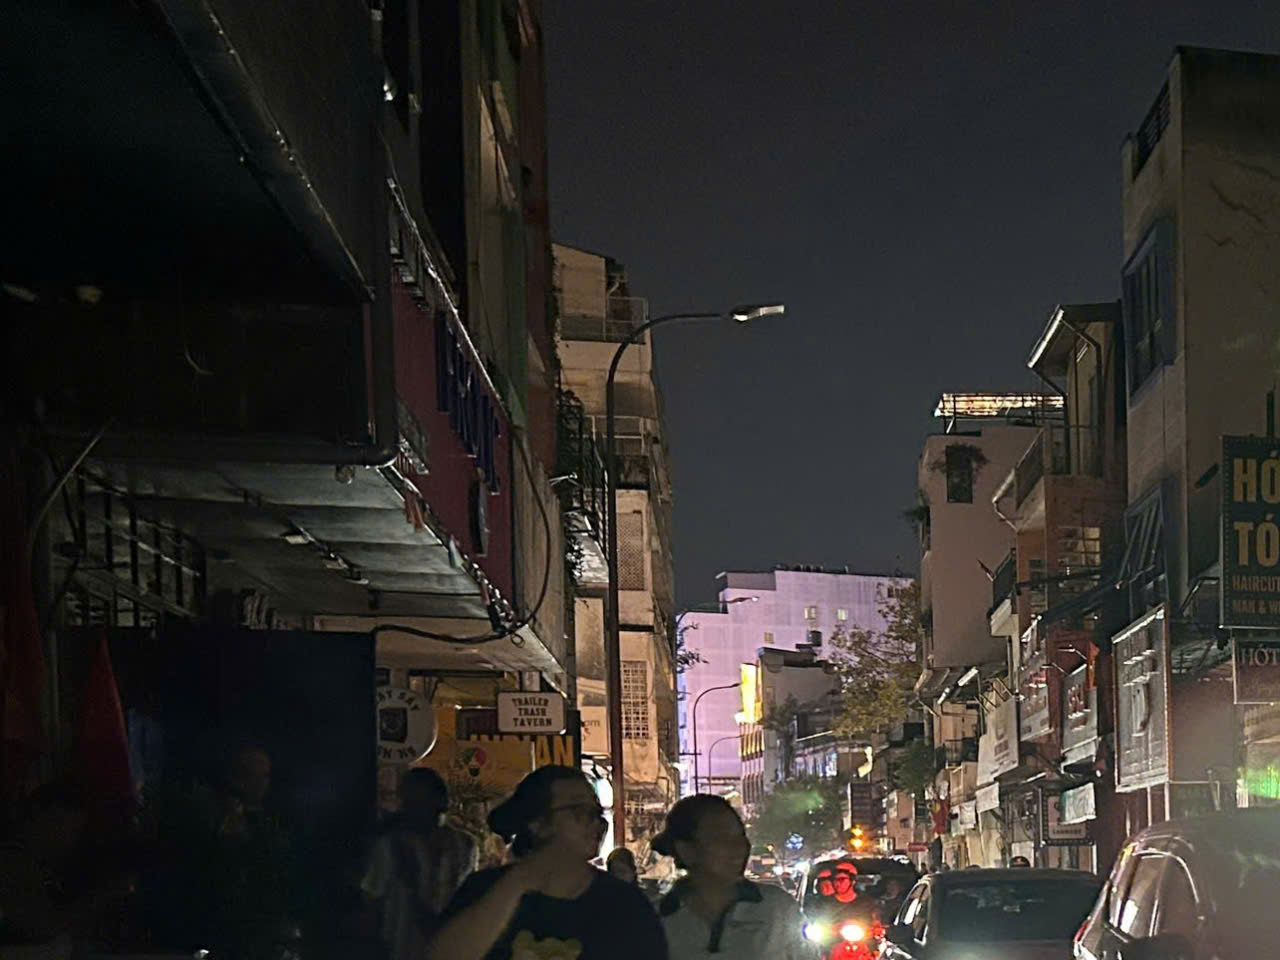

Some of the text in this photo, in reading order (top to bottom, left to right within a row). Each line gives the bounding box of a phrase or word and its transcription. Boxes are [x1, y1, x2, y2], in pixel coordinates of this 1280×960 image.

[1232, 575, 1280, 592] HAIRCUT
[512, 697, 549, 706] TRAILER
[518, 707, 547, 716] TRASH
[513, 718, 552, 727] TAVERN
